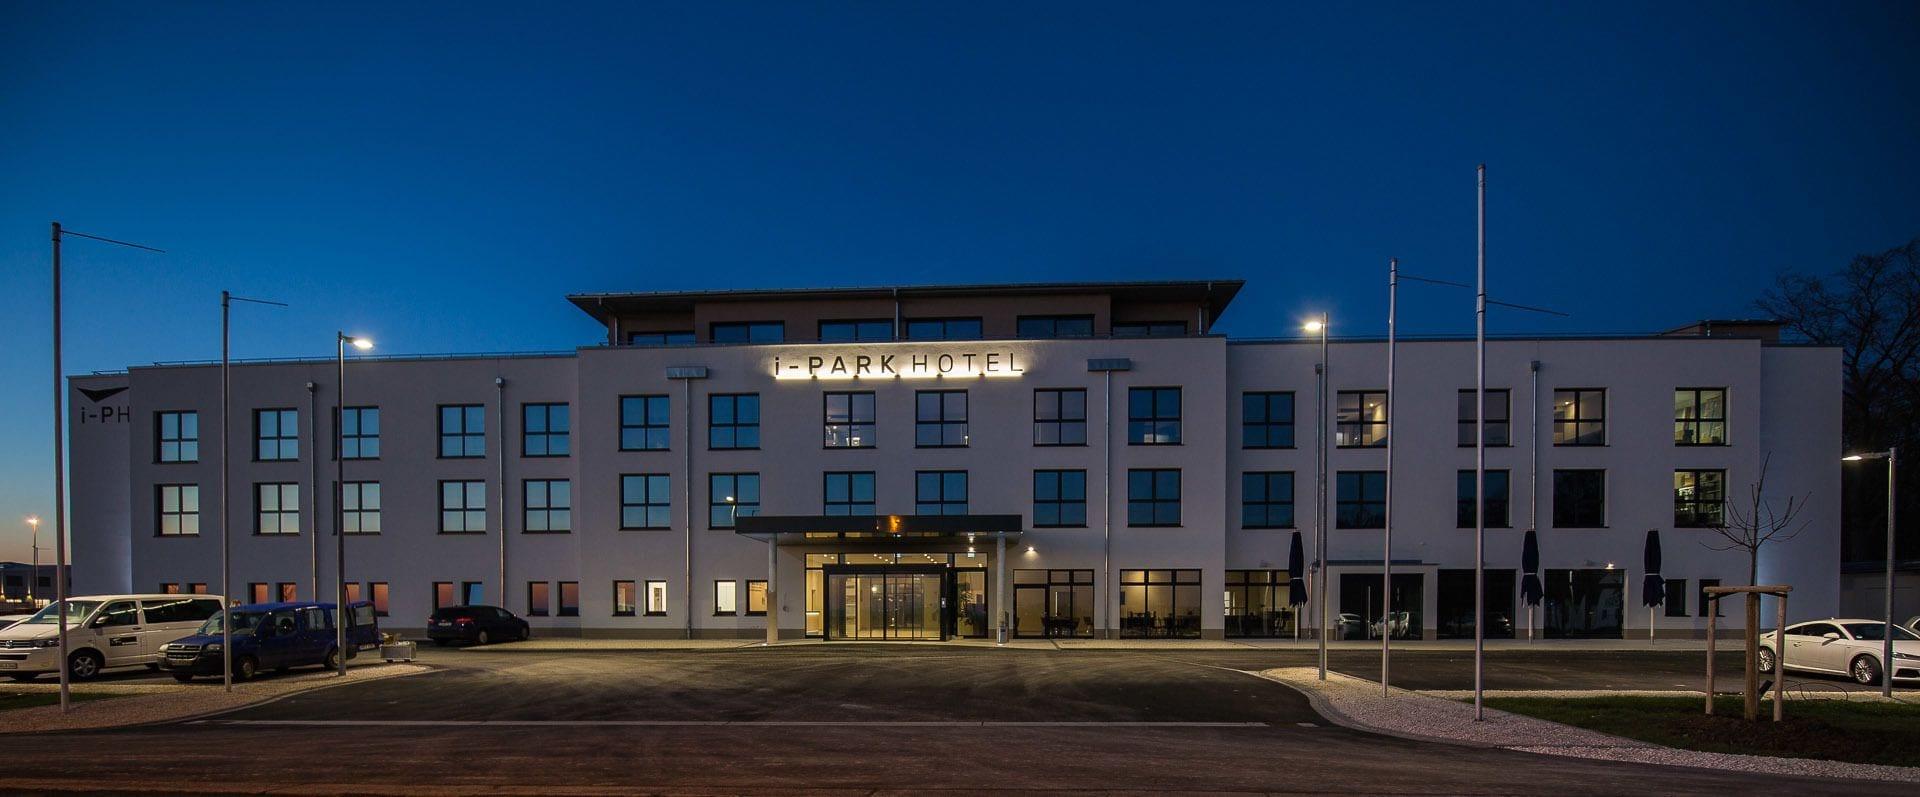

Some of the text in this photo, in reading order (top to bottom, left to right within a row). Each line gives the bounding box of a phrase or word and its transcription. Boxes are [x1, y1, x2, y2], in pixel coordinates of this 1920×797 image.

[774, 352, 1023, 375] i-PARK HOTEL
[81, 406, 130, 424] i-PH
